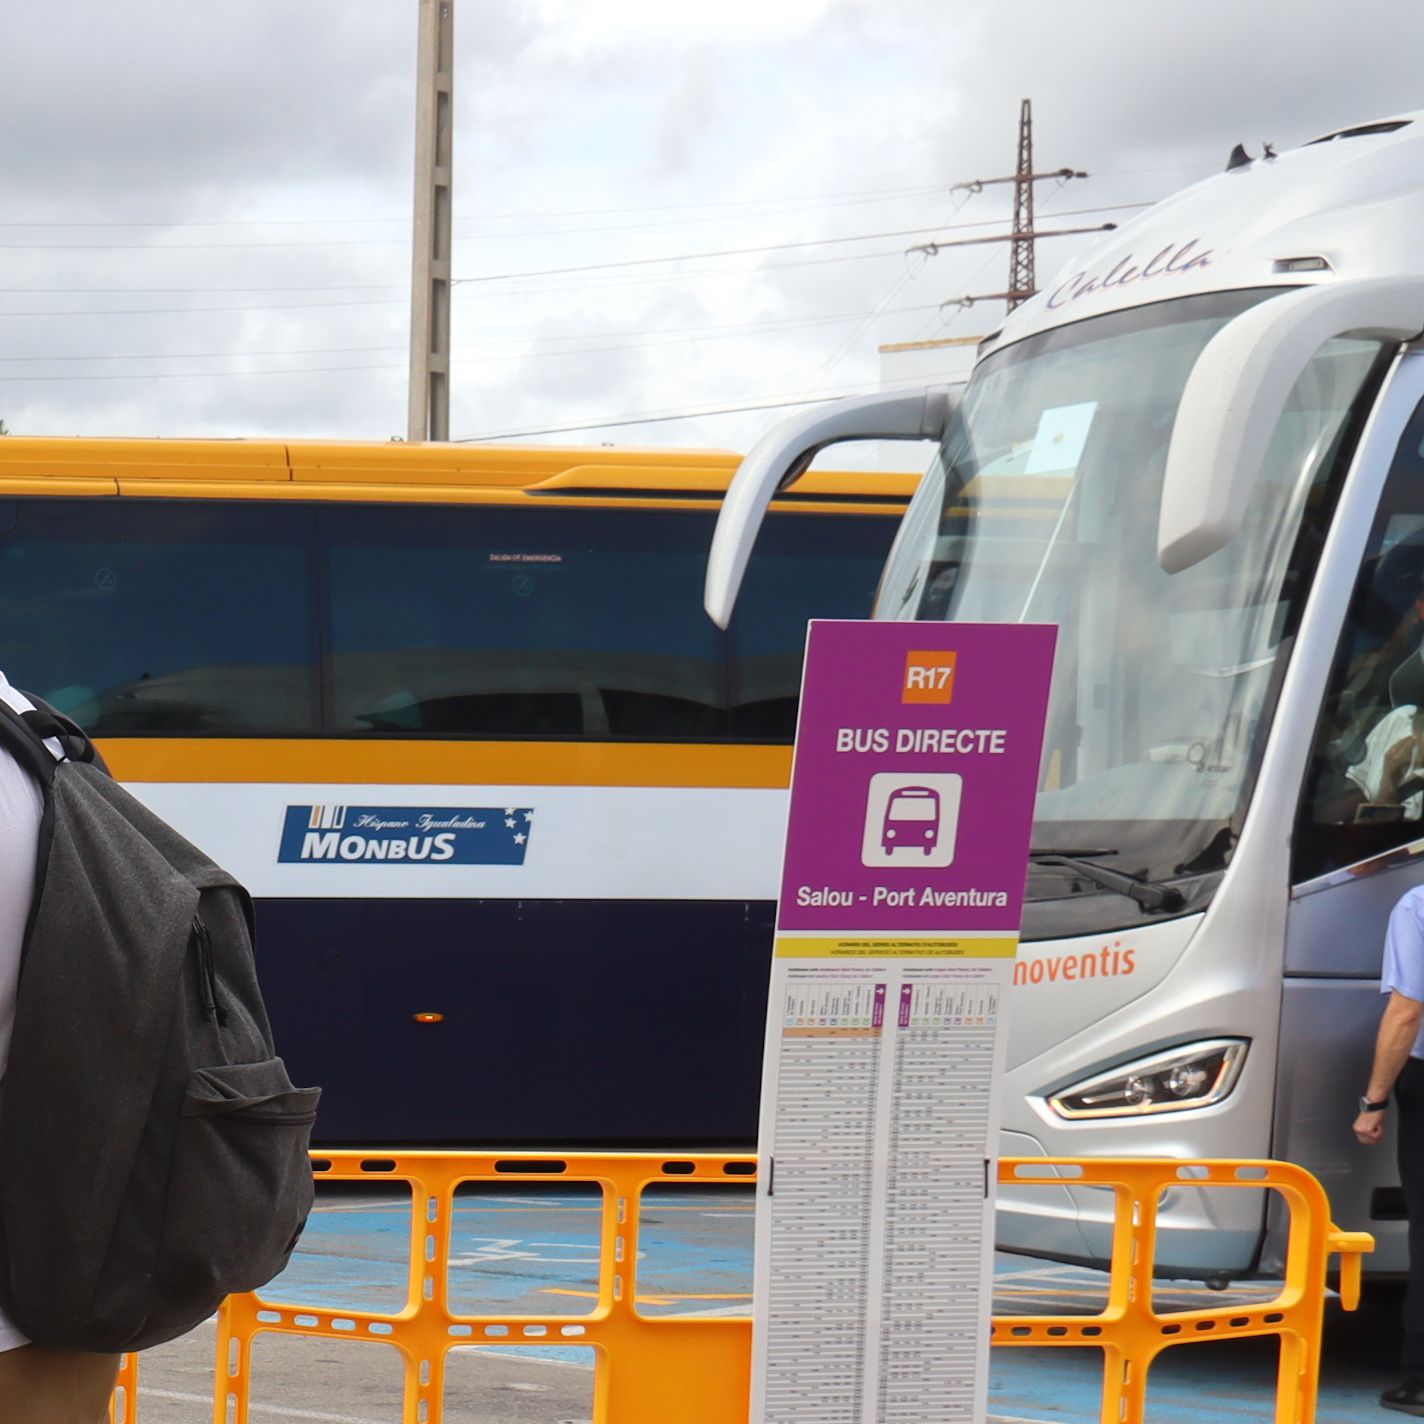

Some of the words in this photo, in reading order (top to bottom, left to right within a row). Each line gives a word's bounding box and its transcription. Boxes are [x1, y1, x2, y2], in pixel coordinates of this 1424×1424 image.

[1046, 238, 1214, 309] Calella
[906, 667, 951, 689] R17
[836, 728, 889, 752] BUS
[896, 729, 1006, 754] DIRECTE
[353, 814, 408, 831] Hispano
[300, 832, 456, 860] MONBUS
[797, 886, 853, 906] Salou
[872, 887, 914, 906] Port
[918, 887, 1007, 907] Aventura
